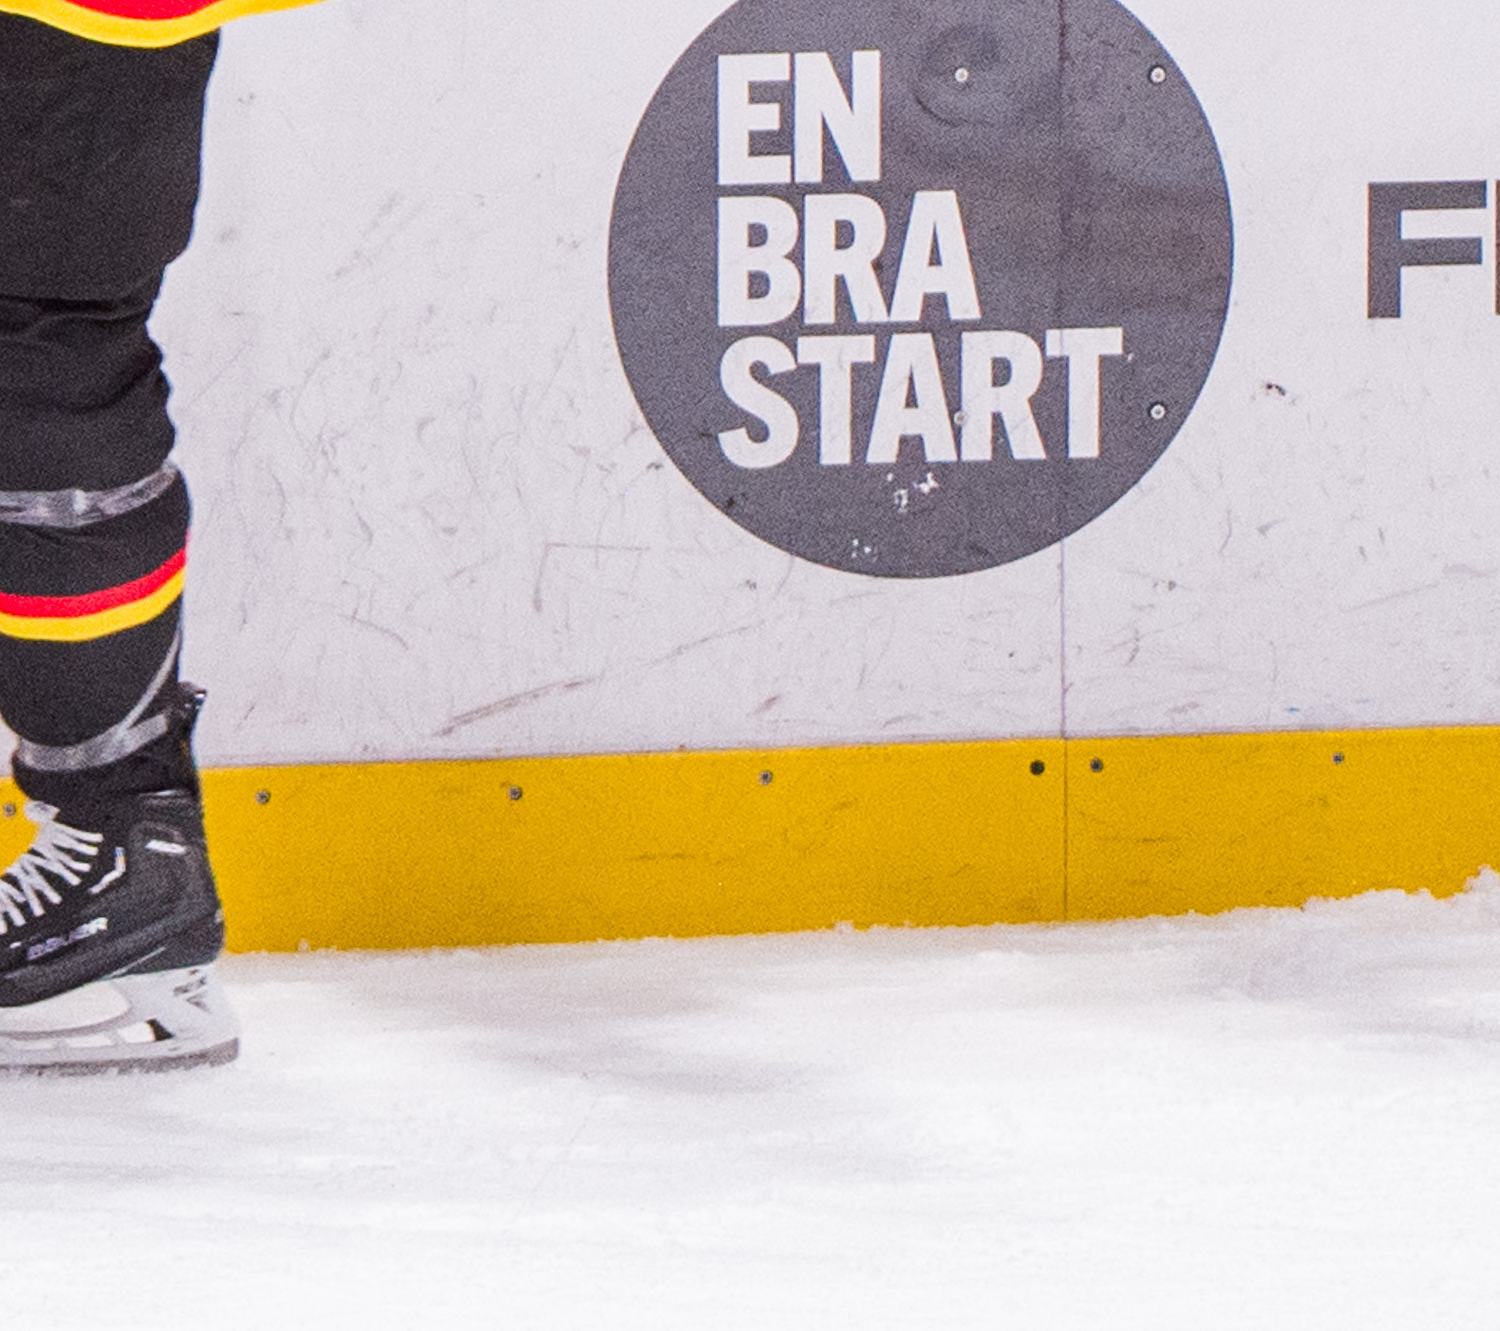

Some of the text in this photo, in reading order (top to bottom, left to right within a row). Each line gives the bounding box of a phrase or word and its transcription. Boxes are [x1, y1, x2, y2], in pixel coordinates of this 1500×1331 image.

[716, 48, 882, 186] EN
[716, 189, 982, 329] BRA
[1366, 178, 1500, 320] F
[716, 326, 1124, 470] START
